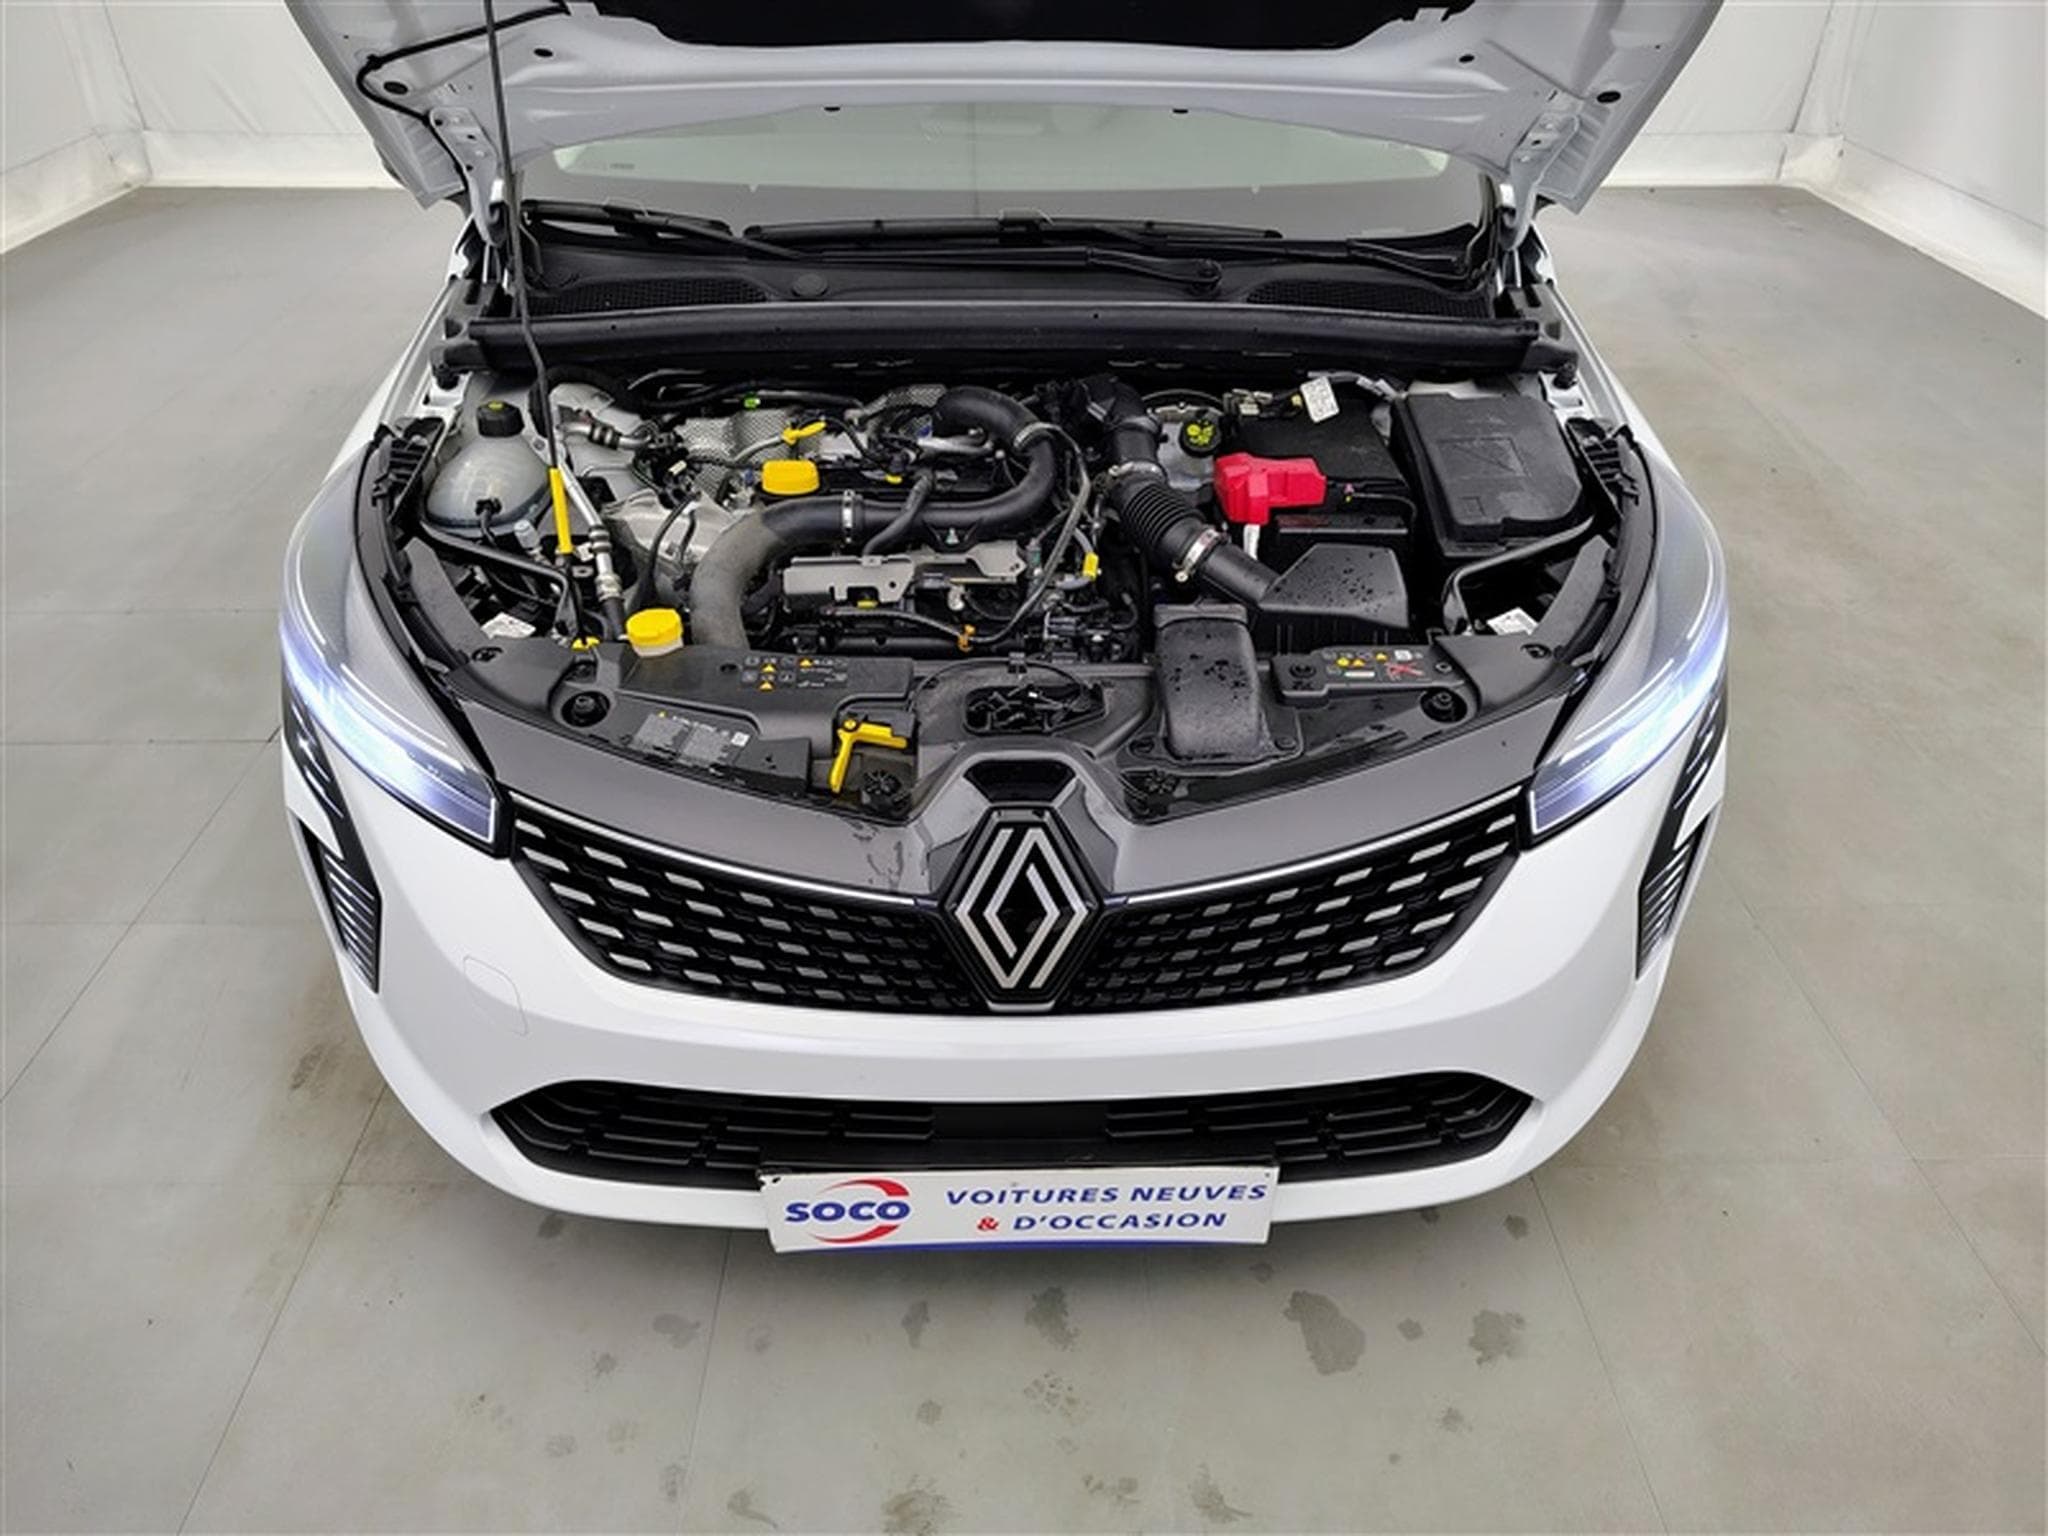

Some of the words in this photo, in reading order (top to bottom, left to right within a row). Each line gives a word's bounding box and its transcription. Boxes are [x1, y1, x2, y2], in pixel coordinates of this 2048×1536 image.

[946, 1187, 1119, 1206] VOITURES
[1130, 1184, 1267, 1203] NEUVES
[785, 1200, 911, 1223] SOCO
[976, 1216, 999, 1232] &
[1013, 1212, 1227, 1231] D'OCCASION
